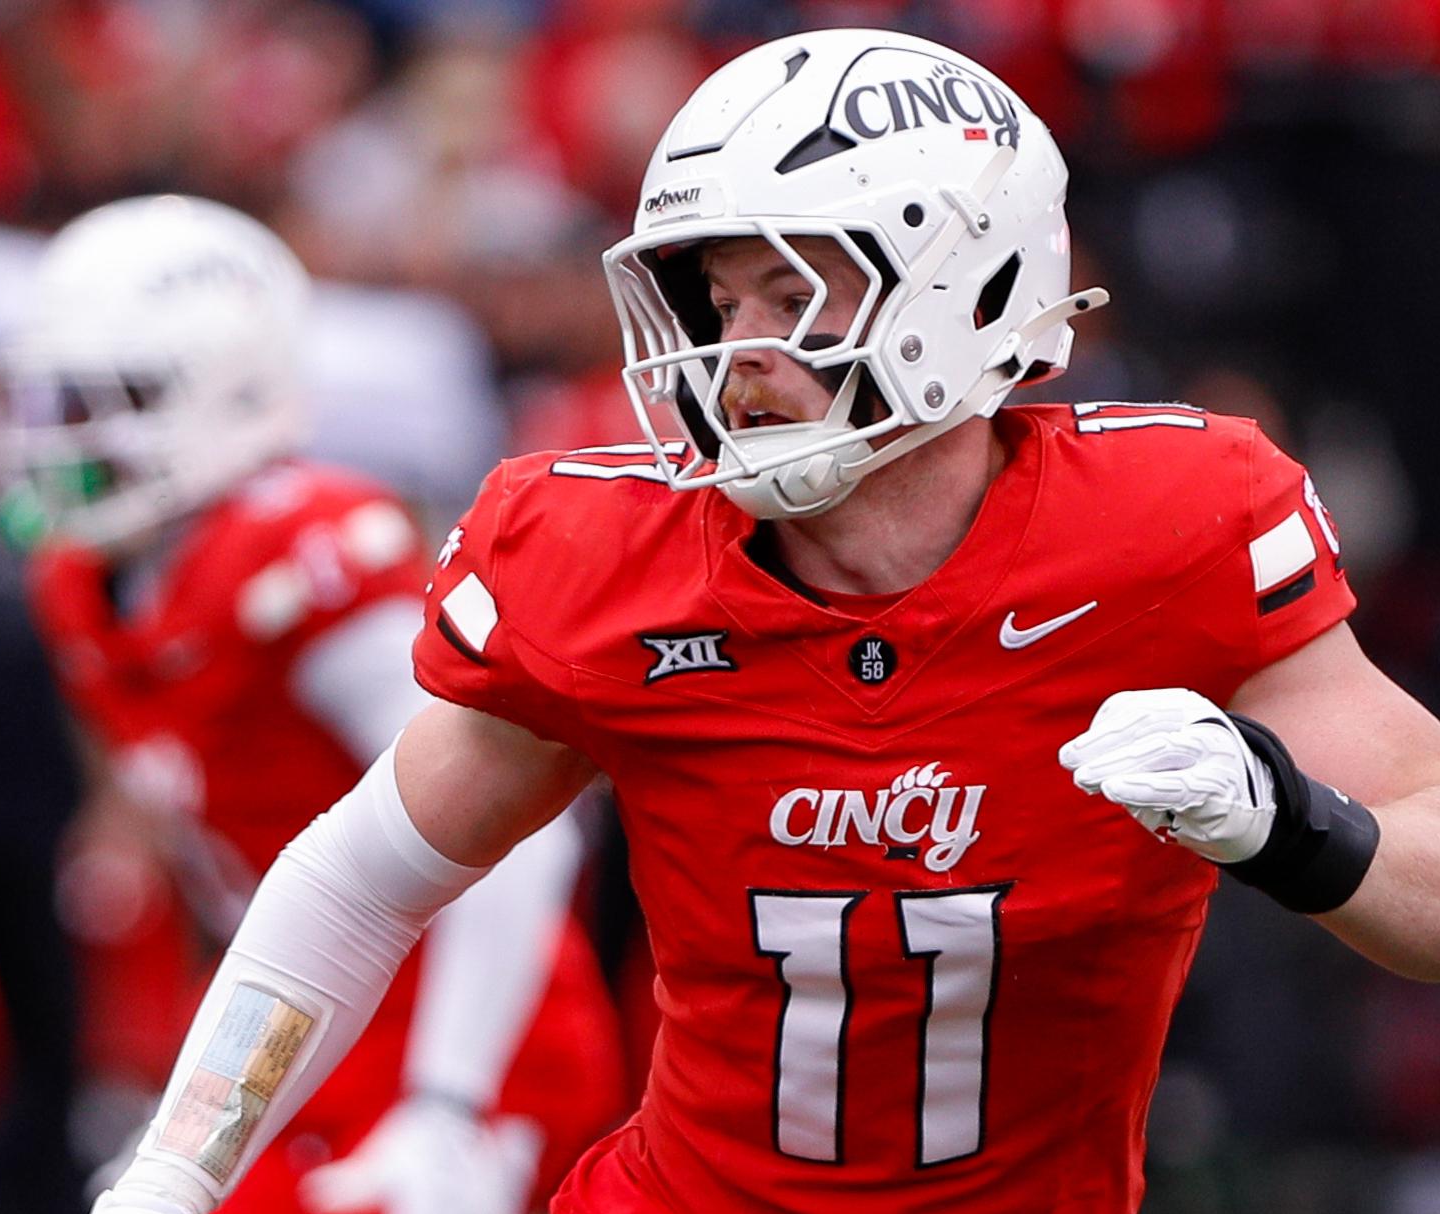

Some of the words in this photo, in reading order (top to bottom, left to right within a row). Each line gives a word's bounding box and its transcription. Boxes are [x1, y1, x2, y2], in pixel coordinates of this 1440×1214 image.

[642, 633, 732, 680] XII
[860, 641, 882, 660] JK
[861, 661, 884, 680] 58
[769, 784, 987, 873] CINCY
[745, 880, 1019, 1170] 11
